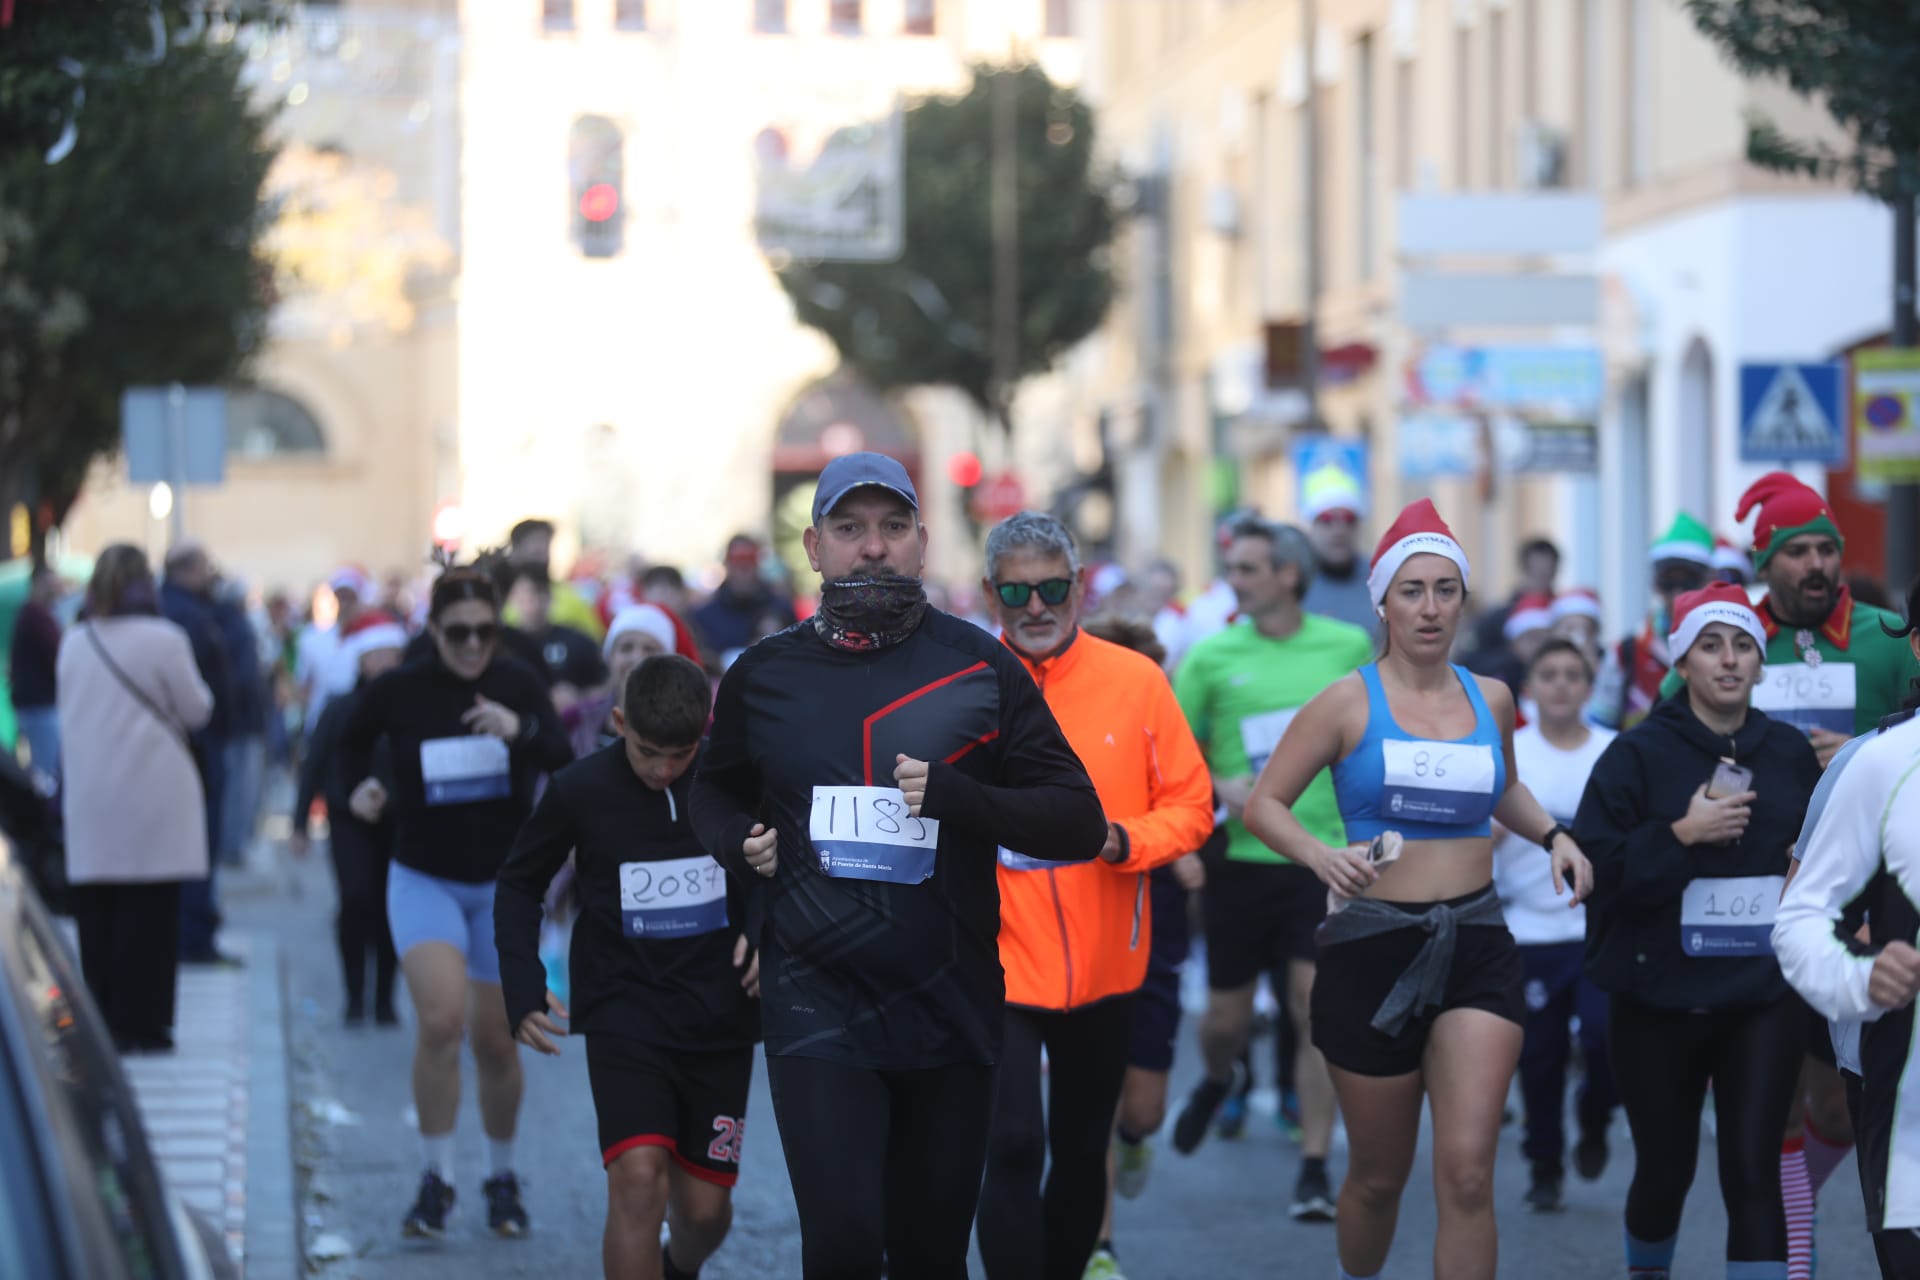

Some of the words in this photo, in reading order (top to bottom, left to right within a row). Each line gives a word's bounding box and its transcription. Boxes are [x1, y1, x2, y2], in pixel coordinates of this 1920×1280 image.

[1775, 672, 1833, 699] 905
[1413, 750, 1456, 778] 86
[630, 863, 719, 904] 2087
[1703, 892, 1765, 917] 106
